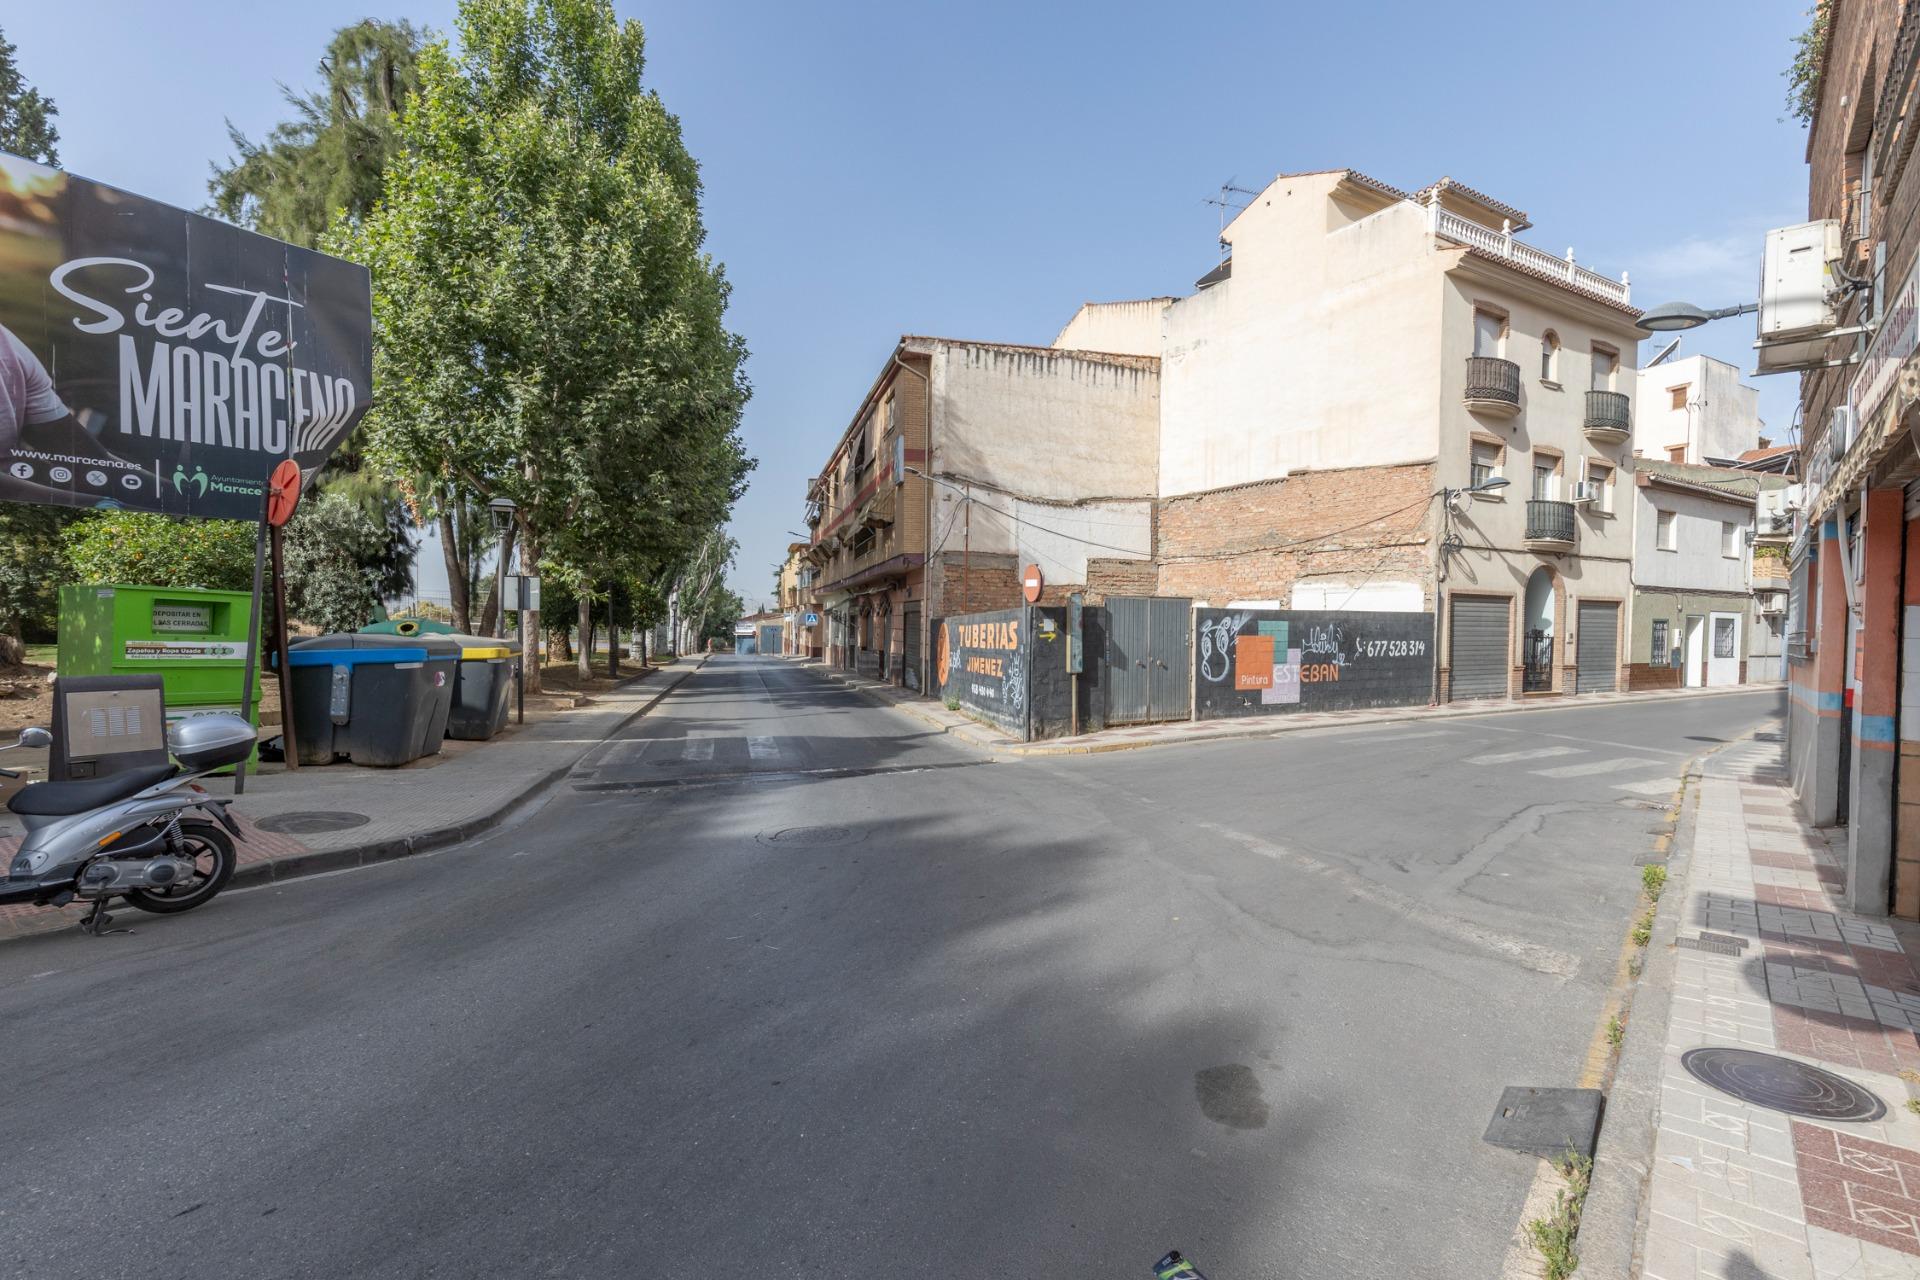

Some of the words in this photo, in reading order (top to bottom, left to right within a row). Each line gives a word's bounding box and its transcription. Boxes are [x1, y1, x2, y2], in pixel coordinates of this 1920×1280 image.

[119, 333, 355, 455] MARACENA
[10, 448, 142, 471] www.maracena.es
[210, 481, 263, 496] Marace
[152, 610, 191, 618] DEPOSITAR
[959, 621, 1018, 650] TUBERIAS
[1388, 640, 1407, 657] 528
[1408, 640, 1425, 656] 314
[966, 656, 1003, 678] JIMENEZ
[1273, 663, 1339, 683] ESTEBAN
